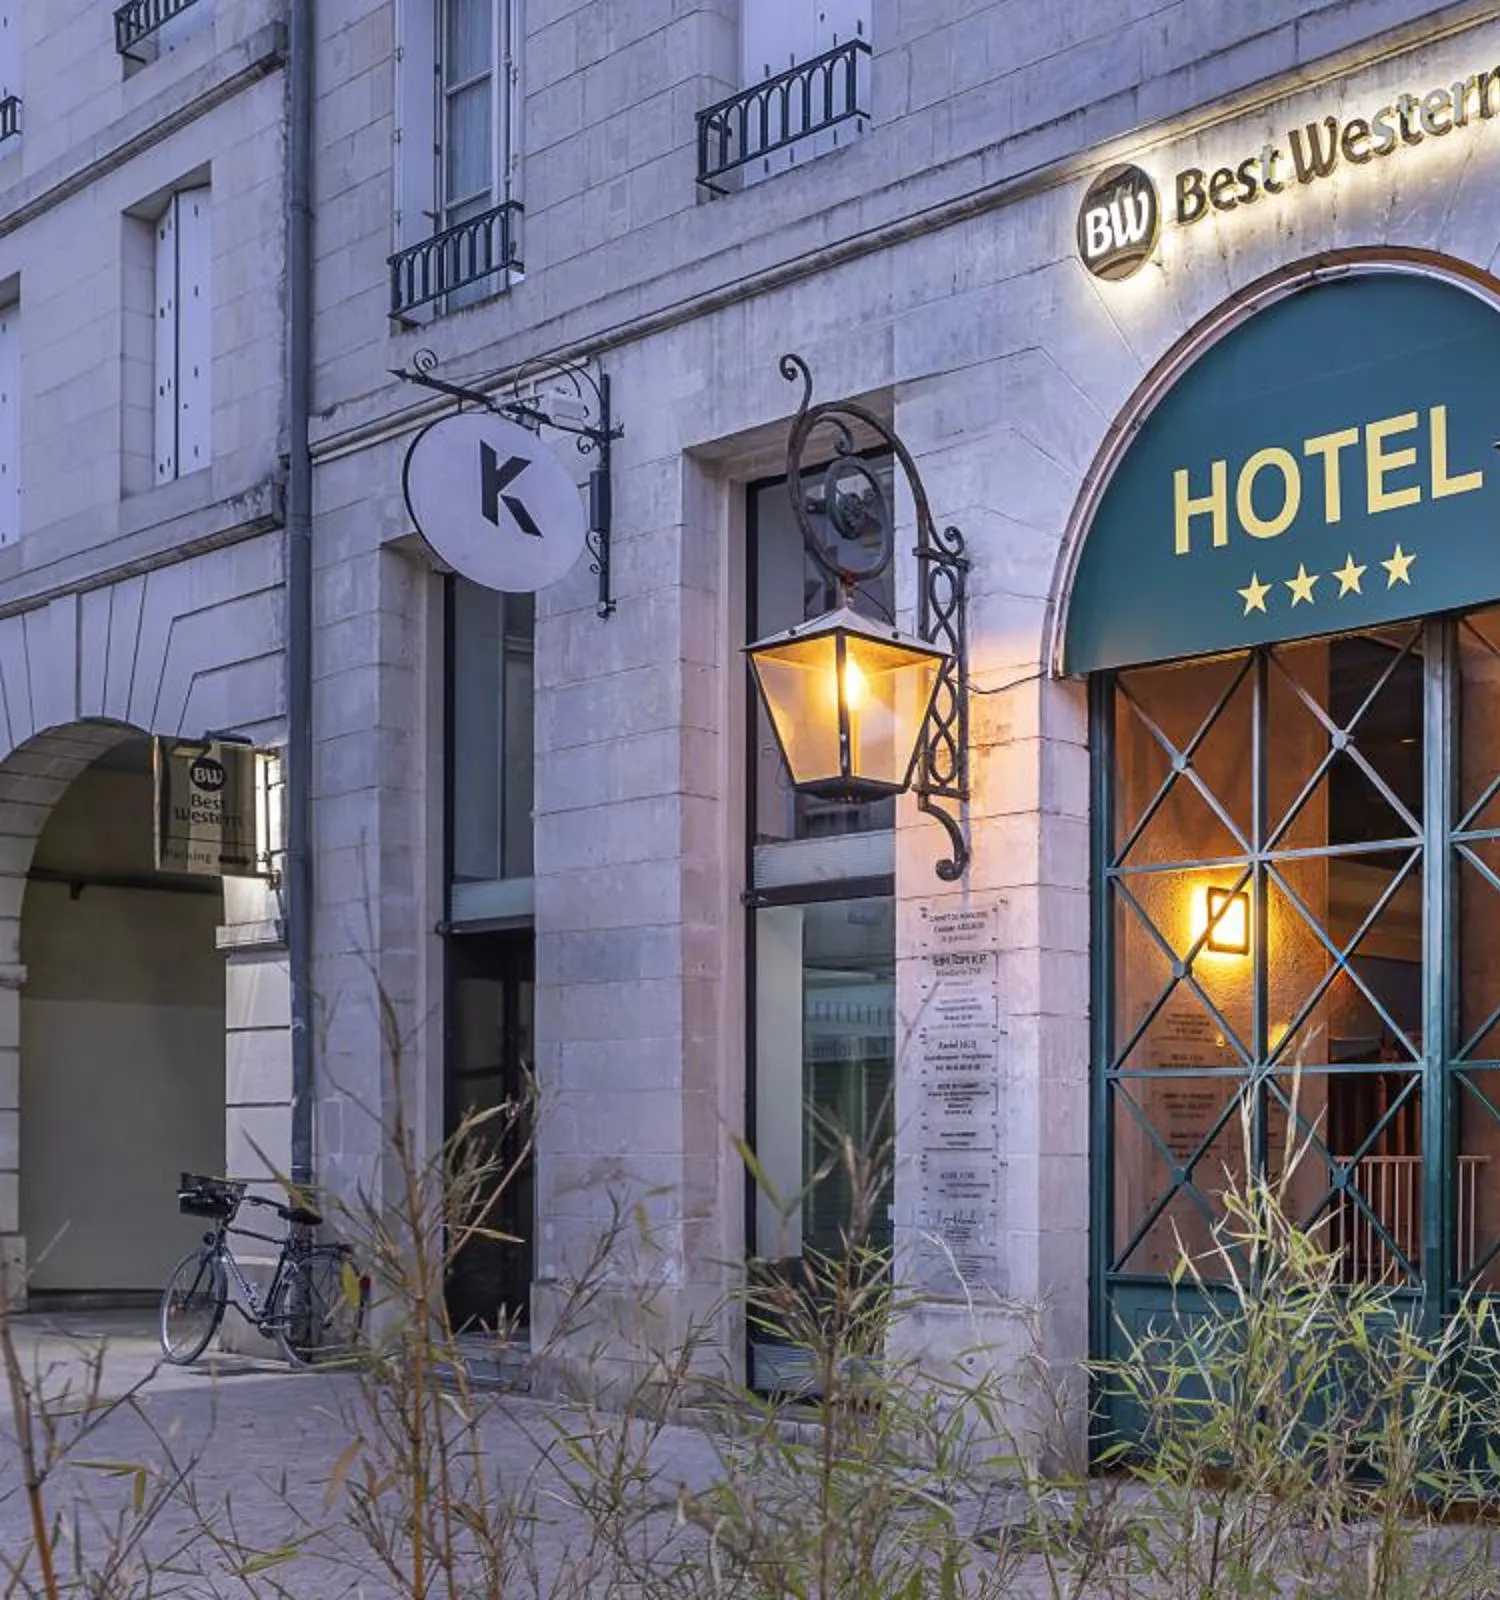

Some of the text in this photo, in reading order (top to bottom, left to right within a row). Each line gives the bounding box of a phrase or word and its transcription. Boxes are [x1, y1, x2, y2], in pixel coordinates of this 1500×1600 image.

[1085, 191, 1150, 258] BW
[1175, 143, 1285, 227] Best
[480, 439, 544, 538] K
[1173, 404, 1484, 556] HOTEL
[191, 793, 225, 811] Best
[193, 766, 223, 786] BW
